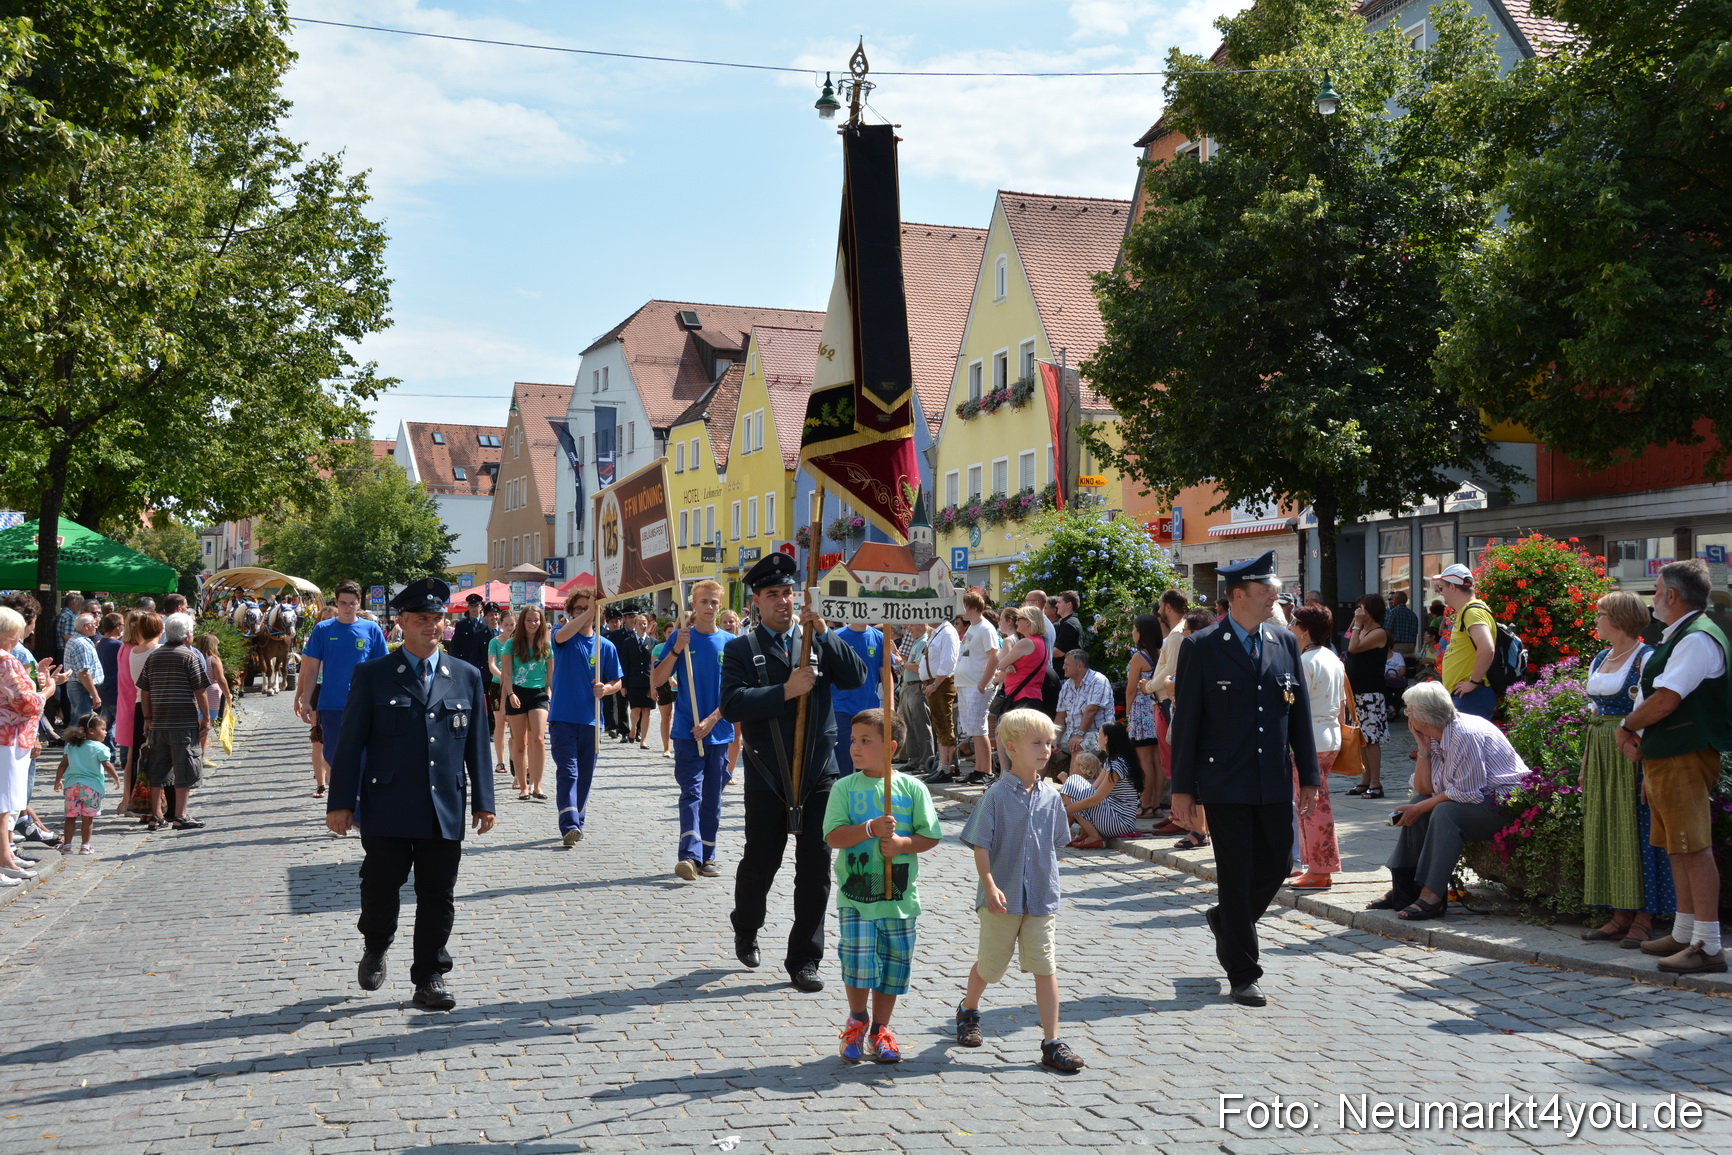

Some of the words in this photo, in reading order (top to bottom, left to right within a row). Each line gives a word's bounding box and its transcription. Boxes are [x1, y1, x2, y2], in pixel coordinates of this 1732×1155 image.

[624, 495, 638, 519] FFW
[638, 483, 663, 513] MÖNING
[683, 488, 700, 504] HOTEL
[602, 520, 618, 559] 125
[681, 563, 704, 574] Restaurant
[881, 602, 954, 621] Möning
